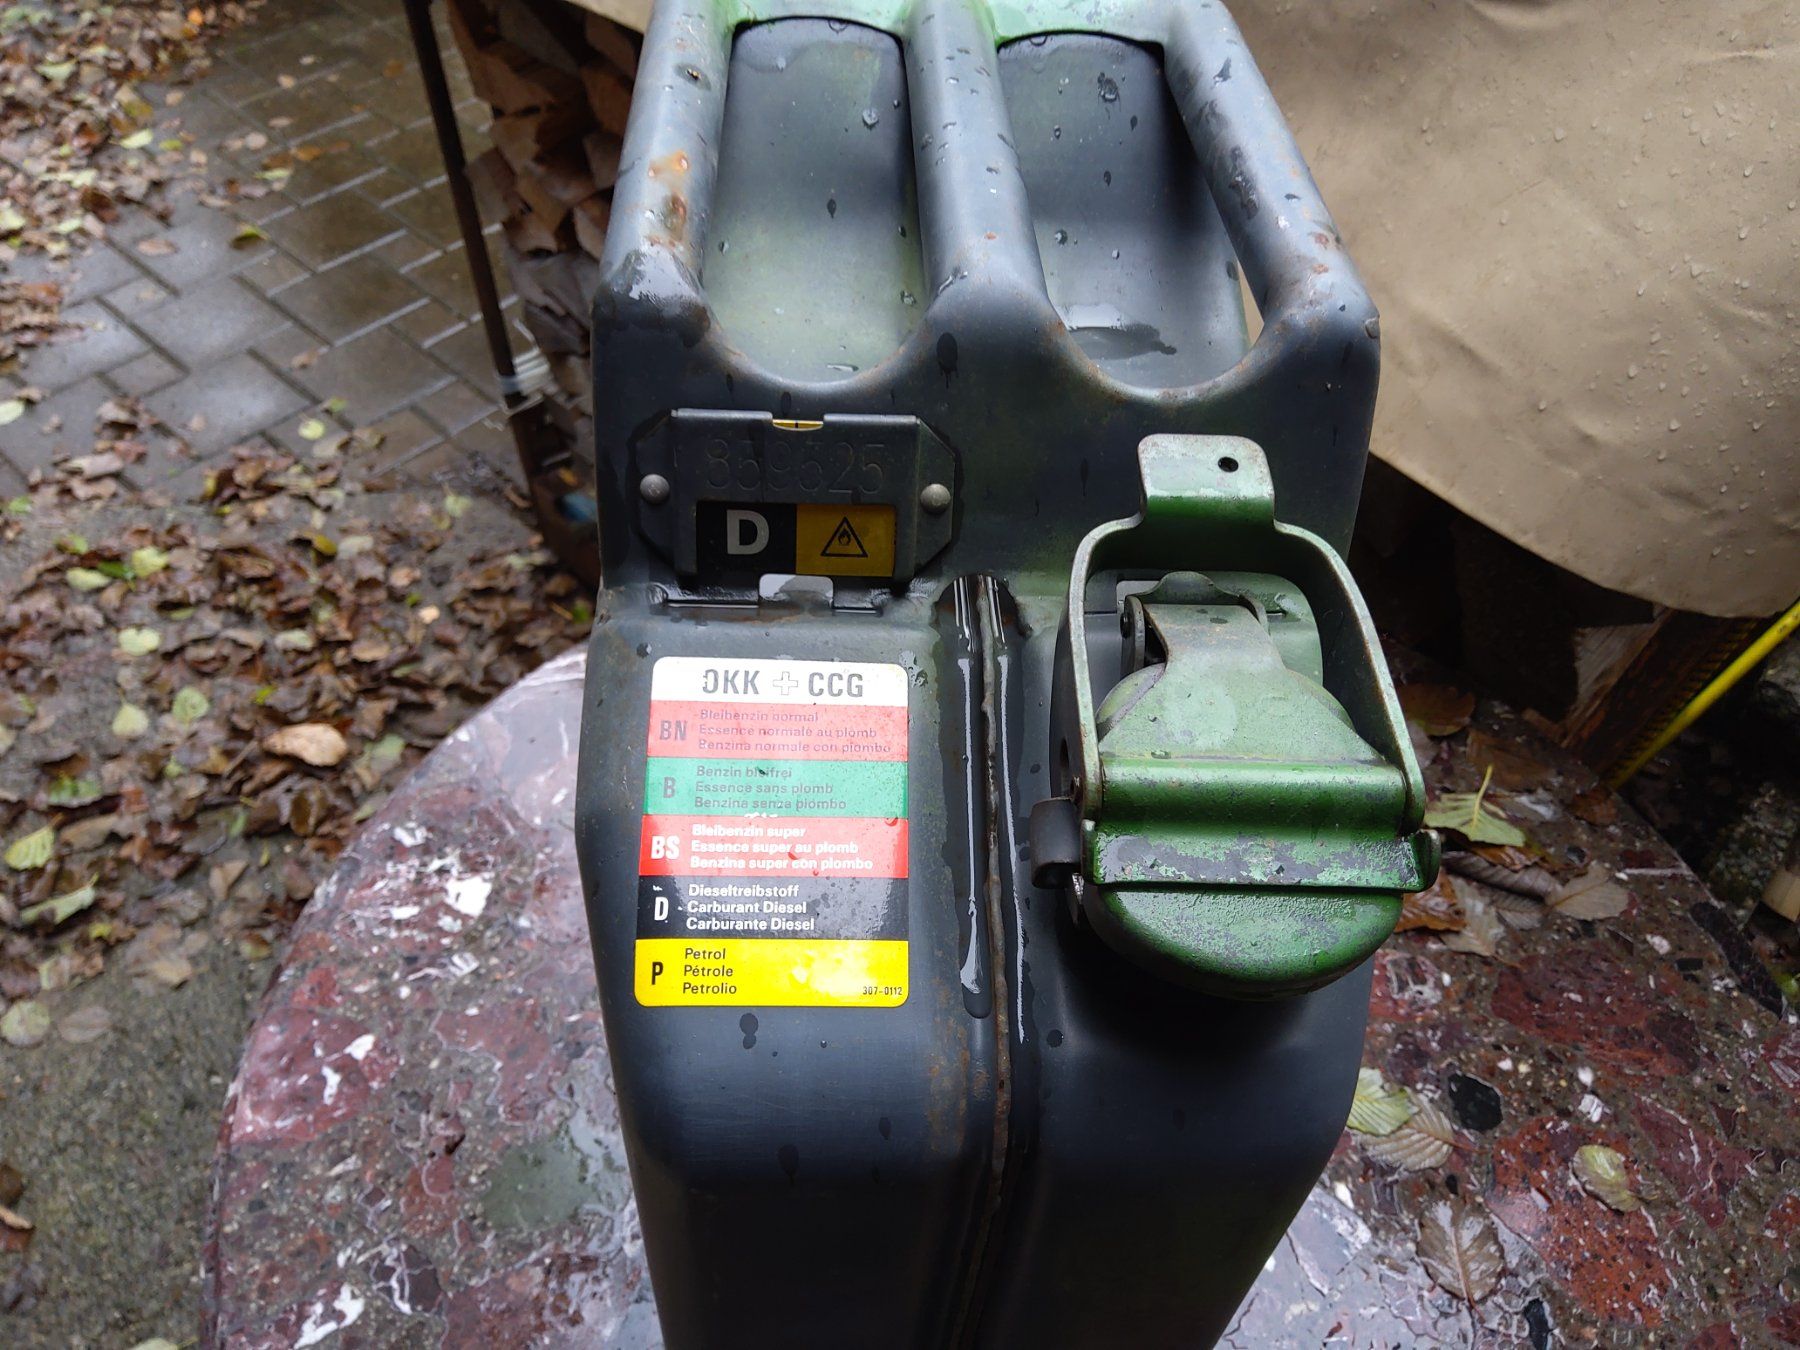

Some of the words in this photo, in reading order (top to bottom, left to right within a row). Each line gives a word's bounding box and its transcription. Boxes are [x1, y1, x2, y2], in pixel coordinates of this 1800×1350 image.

[726, 509, 770, 555] D
[808, 672, 864, 698] CCG
[700, 709, 768, 721] Bleibenzin
[773, 712, 818, 722] normal
[659, 720, 687, 741] BN
[699, 724, 755, 736] Essence
[758, 727, 812, 737] normale
[816, 729, 832, 738] au
[835, 727, 876, 740] plomb
[698, 739, 751, 751] Benzina
[755, 741, 809, 752] normale
[813, 743, 838, 752] con
[842, 742, 891, 754] piombo
[696, 765, 742, 777] Benzin
[663, 777, 677, 799] B
[695, 782, 753, 794] Essence
[756, 784, 788, 795] sans
[791, 783, 833, 797] plomb
[694, 797, 749, 809] Benzina
[752, 800, 792, 809] senza
[796, 798, 847, 812] piombo
[692, 824, 764, 836] Bleibenzin
[767, 828, 806, 839] super
[651, 836, 680, 860] BS
[691, 840, 749, 853] Essence
[752, 843, 791, 855] super
[794, 844, 812, 853] au
[815, 842, 858, 855] plomb
[690, 857, 746, 869] Benzina
[749, 860, 789, 871] super
[791, 860, 818, 869] con
[821, 858, 874, 871] piombo
[688, 883, 799, 897] Dieseltreibstoff
[654, 897, 669, 921] D
[687, 901, 760, 914] Carburant
[762, 901, 807, 914] Diesel
[686, 917, 768, 931] Carburante
[770, 917, 815, 931] Diesel
[685, 948, 726, 960] Petrol
[651, 962, 664, 986] P
[683, 965, 734, 978] Pétrole
[682, 983, 737, 995] Petrolio
[862, 986, 902, 996] 307-0112
